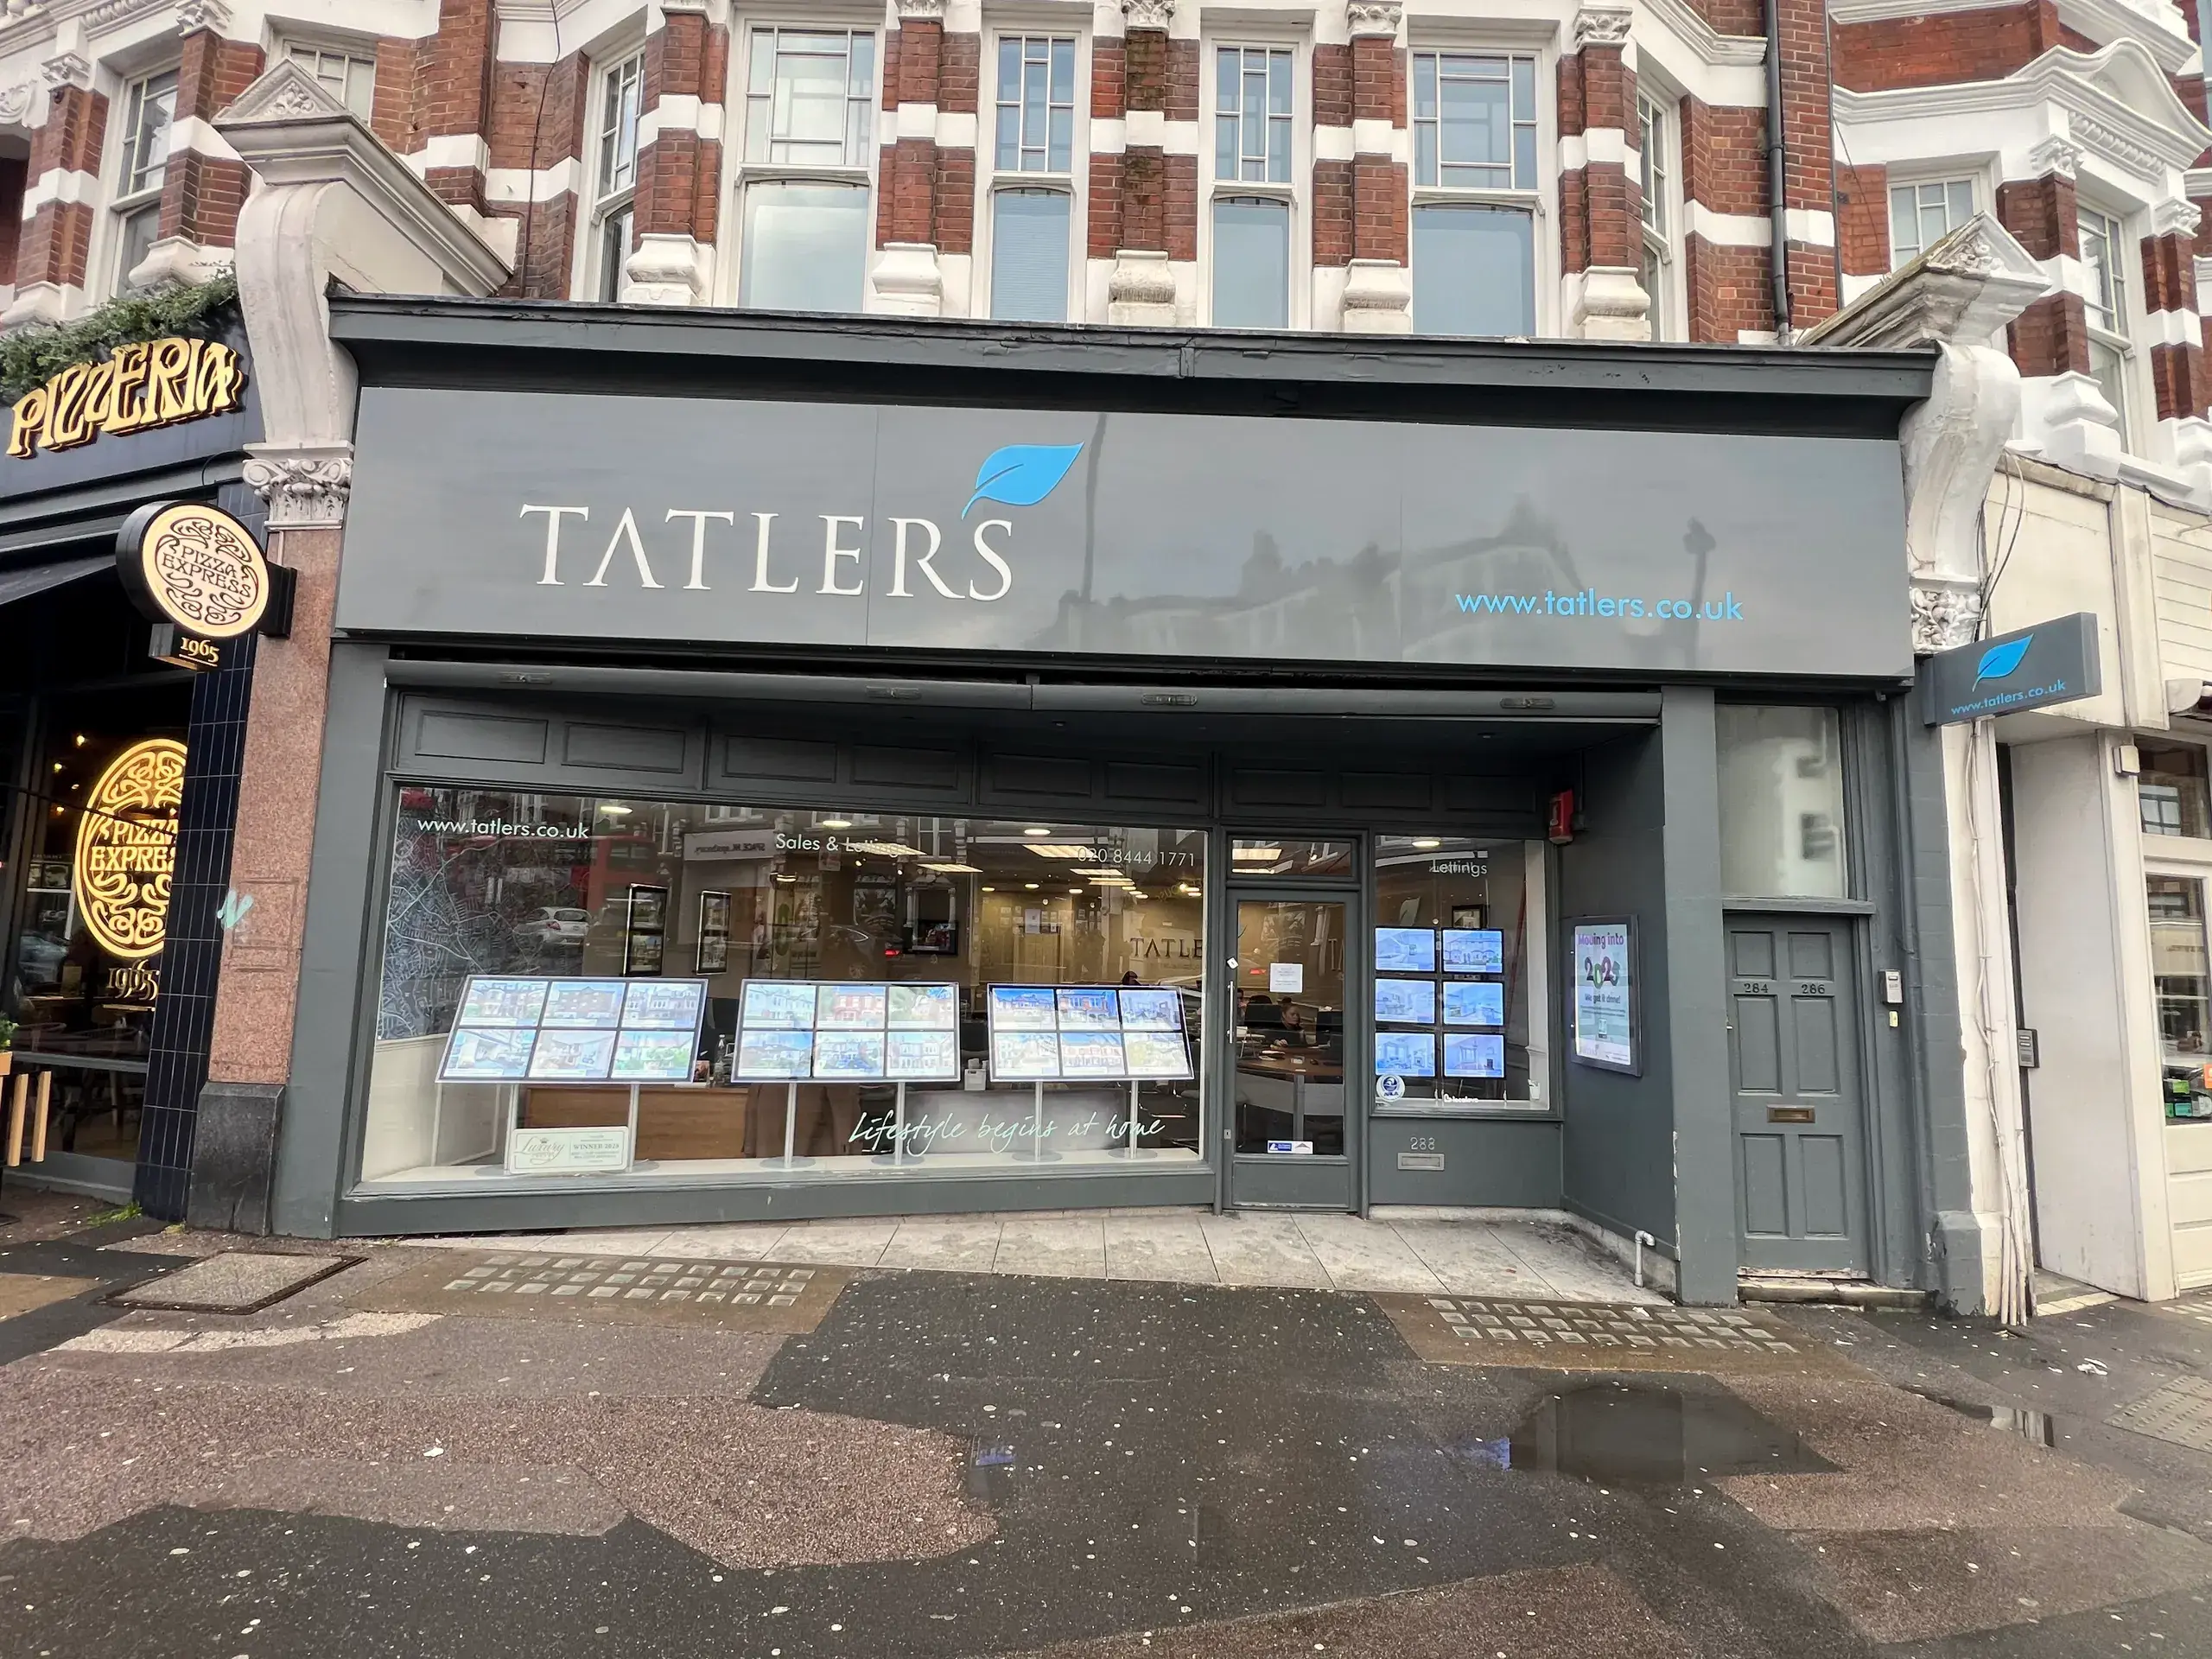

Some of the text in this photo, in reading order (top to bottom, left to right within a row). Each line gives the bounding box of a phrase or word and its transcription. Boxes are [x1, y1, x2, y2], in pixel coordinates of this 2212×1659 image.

[6, 336, 244, 458] PIZZERIA
[181, 544, 238, 579] PIZZA
[519, 504, 1014, 602] TATLERS
[162, 552, 251, 598] EXPRESS
[1455, 588, 1744, 620] www.tatlers.co.uk
[180, 637, 220, 663] 1965
[1950, 678, 2067, 715] www.tatlers.co.uk
[417, 817, 589, 839] www.tatlers.co.uk
[776, 833, 821, 851] Sales
[826, 836, 839, 852] &
[89, 846, 176, 873] EXPRE
[1077, 848, 1195, 867] 020 8444 1771
[1432, 859, 1488, 878] Lettings
[1129, 938, 1203, 959] TATLE
[1578, 931, 1624, 950] Moving into
[106, 958, 160, 1001] 1965
[1744, 982, 1826, 994] 284 286
[849, 1109, 1166, 1157] Lifestyle begins at home
[1410, 1136, 1435, 1150] 288
